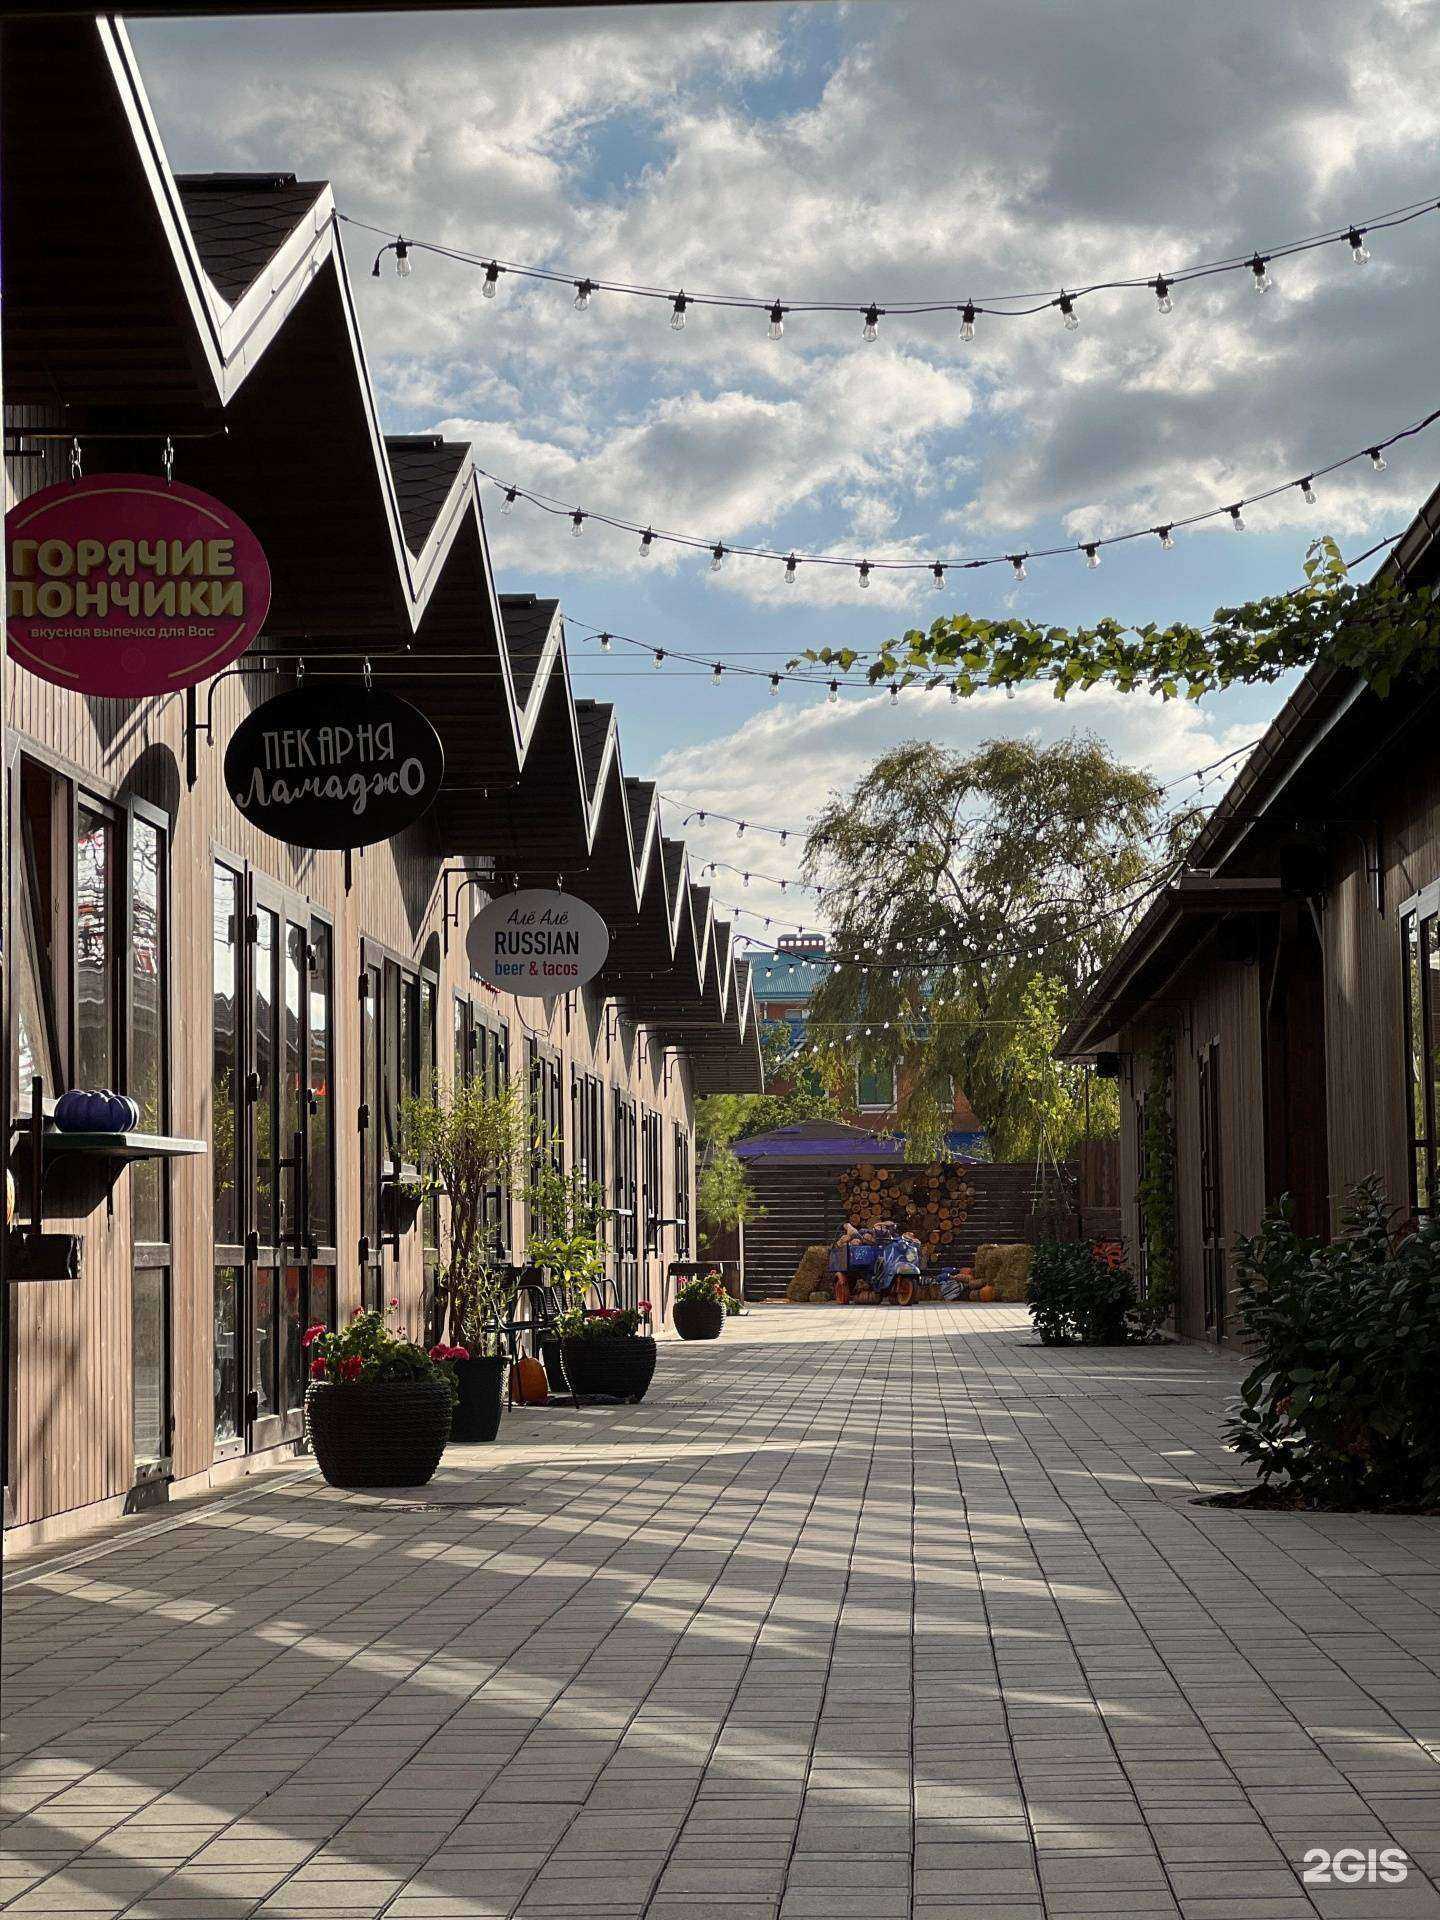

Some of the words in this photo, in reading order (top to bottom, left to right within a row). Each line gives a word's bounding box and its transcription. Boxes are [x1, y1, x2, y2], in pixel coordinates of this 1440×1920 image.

[12, 539, 236, 576] ГОРЯЧИЕ
[7, 581, 245, 618] ПОНЧИКИ
[31, 628, 91, 640] вкусная
[94, 627, 156, 638] выпечка
[159, 627, 186, 639] для
[188, 625, 216, 637] Вас
[262, 722, 395, 770] ПЕКАРНЯ
[507, 908, 536, 925] Алё
[540, 908, 569, 925] Алё
[494, 931, 579, 955] RUSSIAN
[494, 960, 525, 976] beer
[529, 960, 538, 976] &
[543, 961, 578, 976] tacos
